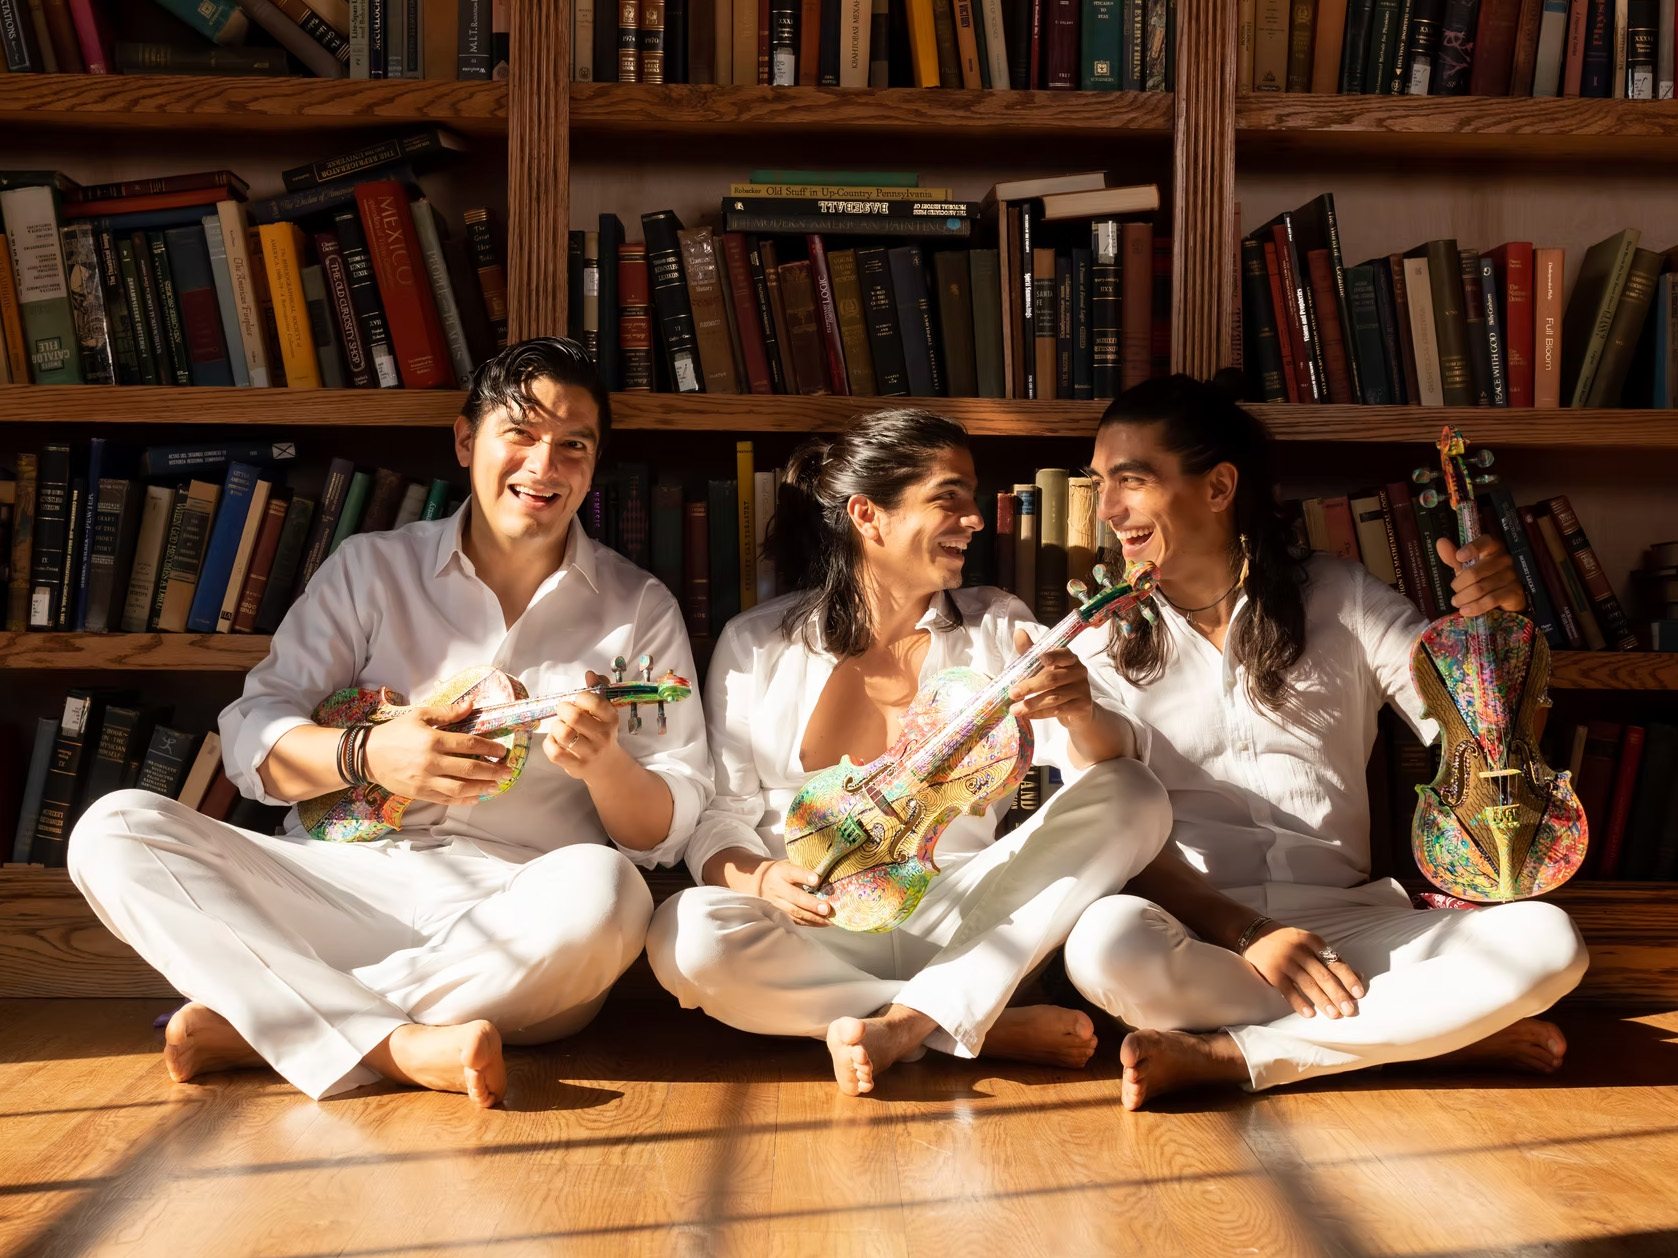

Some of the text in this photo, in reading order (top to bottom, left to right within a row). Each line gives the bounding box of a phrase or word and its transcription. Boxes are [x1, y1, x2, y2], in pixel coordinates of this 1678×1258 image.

[1396, 41, 1405, 68] ANALYSIS
[319, 149, 394, 179] THE REFRIGERATOR
[765, 187, 783, 196] Old
[785, 187, 805, 196] Stuff
[808, 187, 817, 196] in
[821, 188, 872, 199] Up-Country
[875, 189, 932, 200] Pennsylvania
[817, 200, 889, 214] BASEBALL
[750, 217, 944, 232] MODERN AMERICAN PAINTING
[372, 192, 418, 287] MEXICO
[232, 256, 244, 273] The
[816, 274, 831, 304] LOGIC
[1022, 272, 1034, 318] Spirit Summonings
[329, 261, 361, 363] THE OLD CURIOSITY SHOP
[426, 249, 449, 298] PEOPLE
[442, 311, 467, 360] PLACES
[1036, 298, 1042, 306] FE
[30, 348, 70, 363] CATALOG
[37, 340, 58, 352] FILE
[1544, 317, 1554, 371] Full Bloom
[1487, 331, 1503, 404] PEACE WITH GOD
[83, 491, 95, 529] PEWTER
[1378, 487, 1389, 509] LOGIC
[96, 514, 115, 522] CRAFT
[94, 534, 113, 542] SHORT
[1383, 511, 1400, 566] MATHEMATICAL
[1394, 566, 1402, 576] TO
